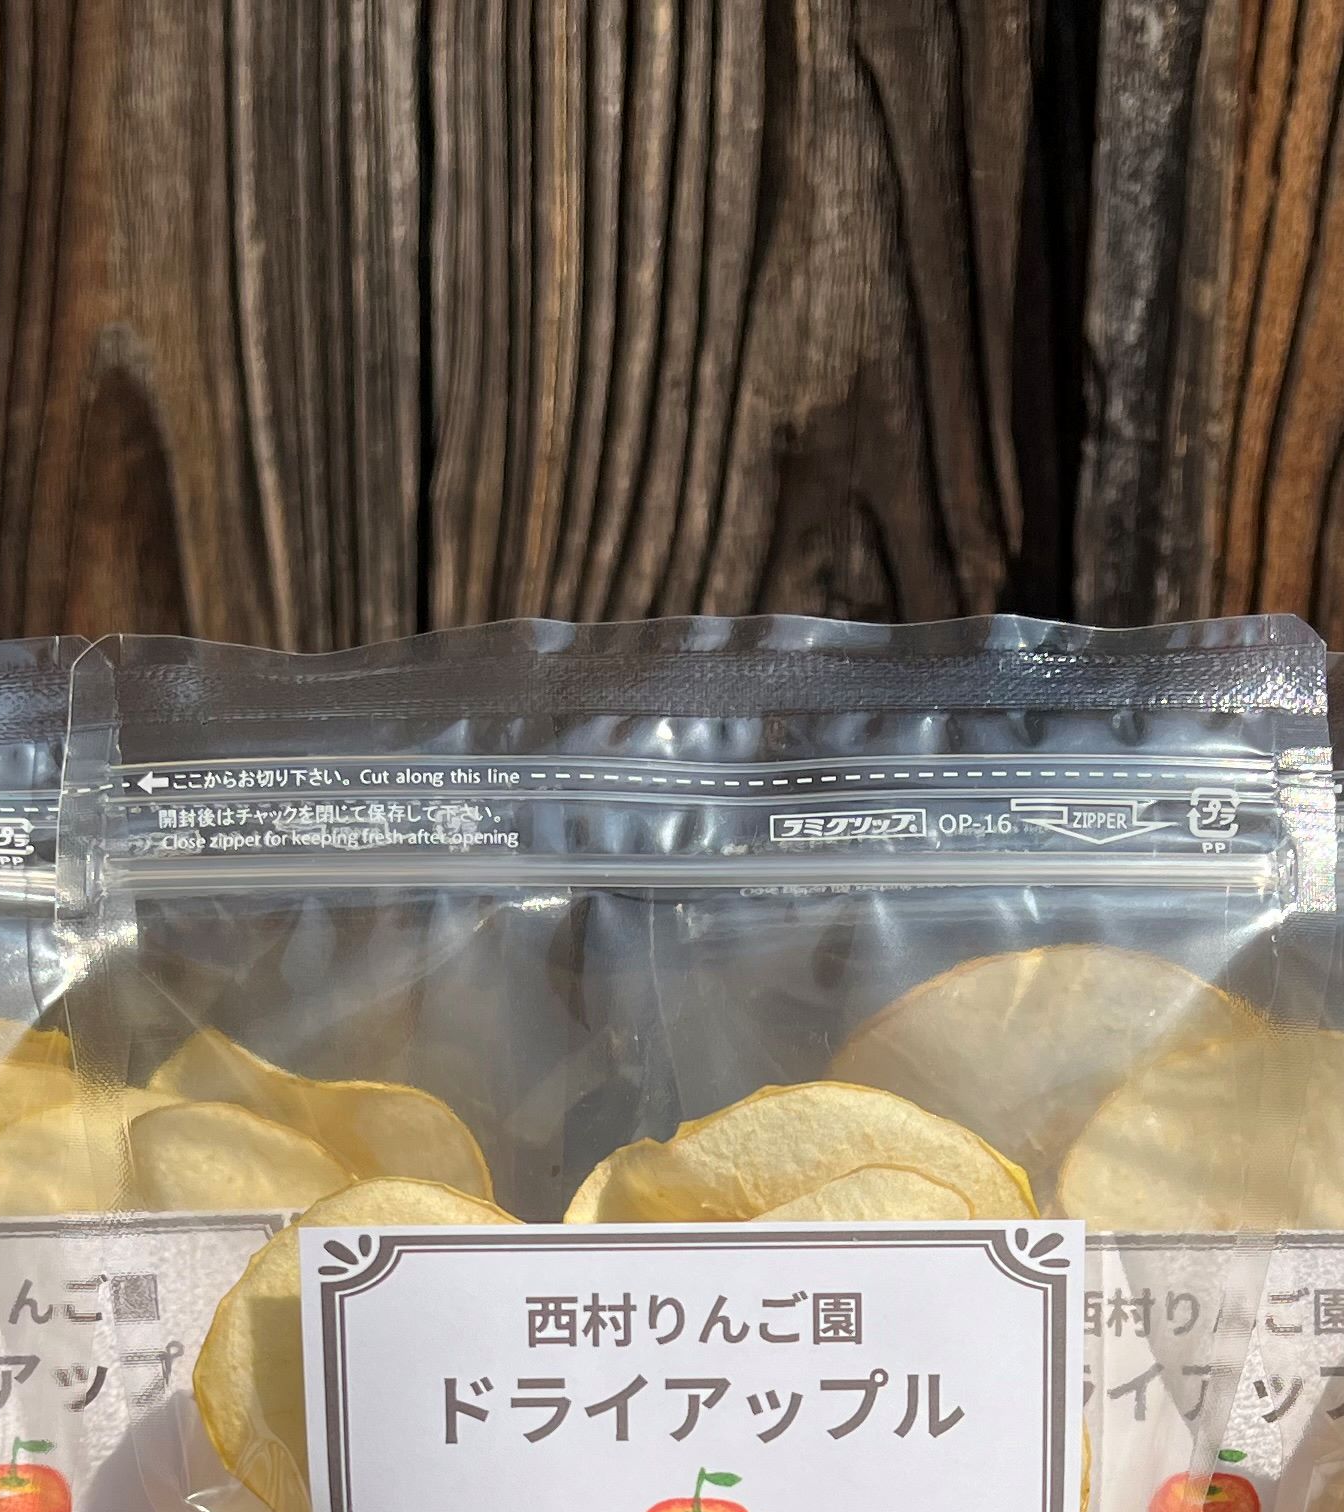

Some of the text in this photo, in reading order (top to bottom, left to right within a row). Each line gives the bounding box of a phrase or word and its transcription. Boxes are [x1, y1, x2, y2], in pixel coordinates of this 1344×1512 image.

[173, 768, 520, 789] ここからお切り下さい。 Cut along this line
[938, 813, 1012, 836] OP-16
[1072, 811, 1128, 830] ZIPPER
[162, 829, 519, 851] Close zipper for keeping fresh after opening
[1202, 842, 1227, 854] PP
[0, 856, 24, 867] PP
[525, 1290, 863, 1348] 西村りんご園
[442, 1368, 965, 1445] ドライアップル
